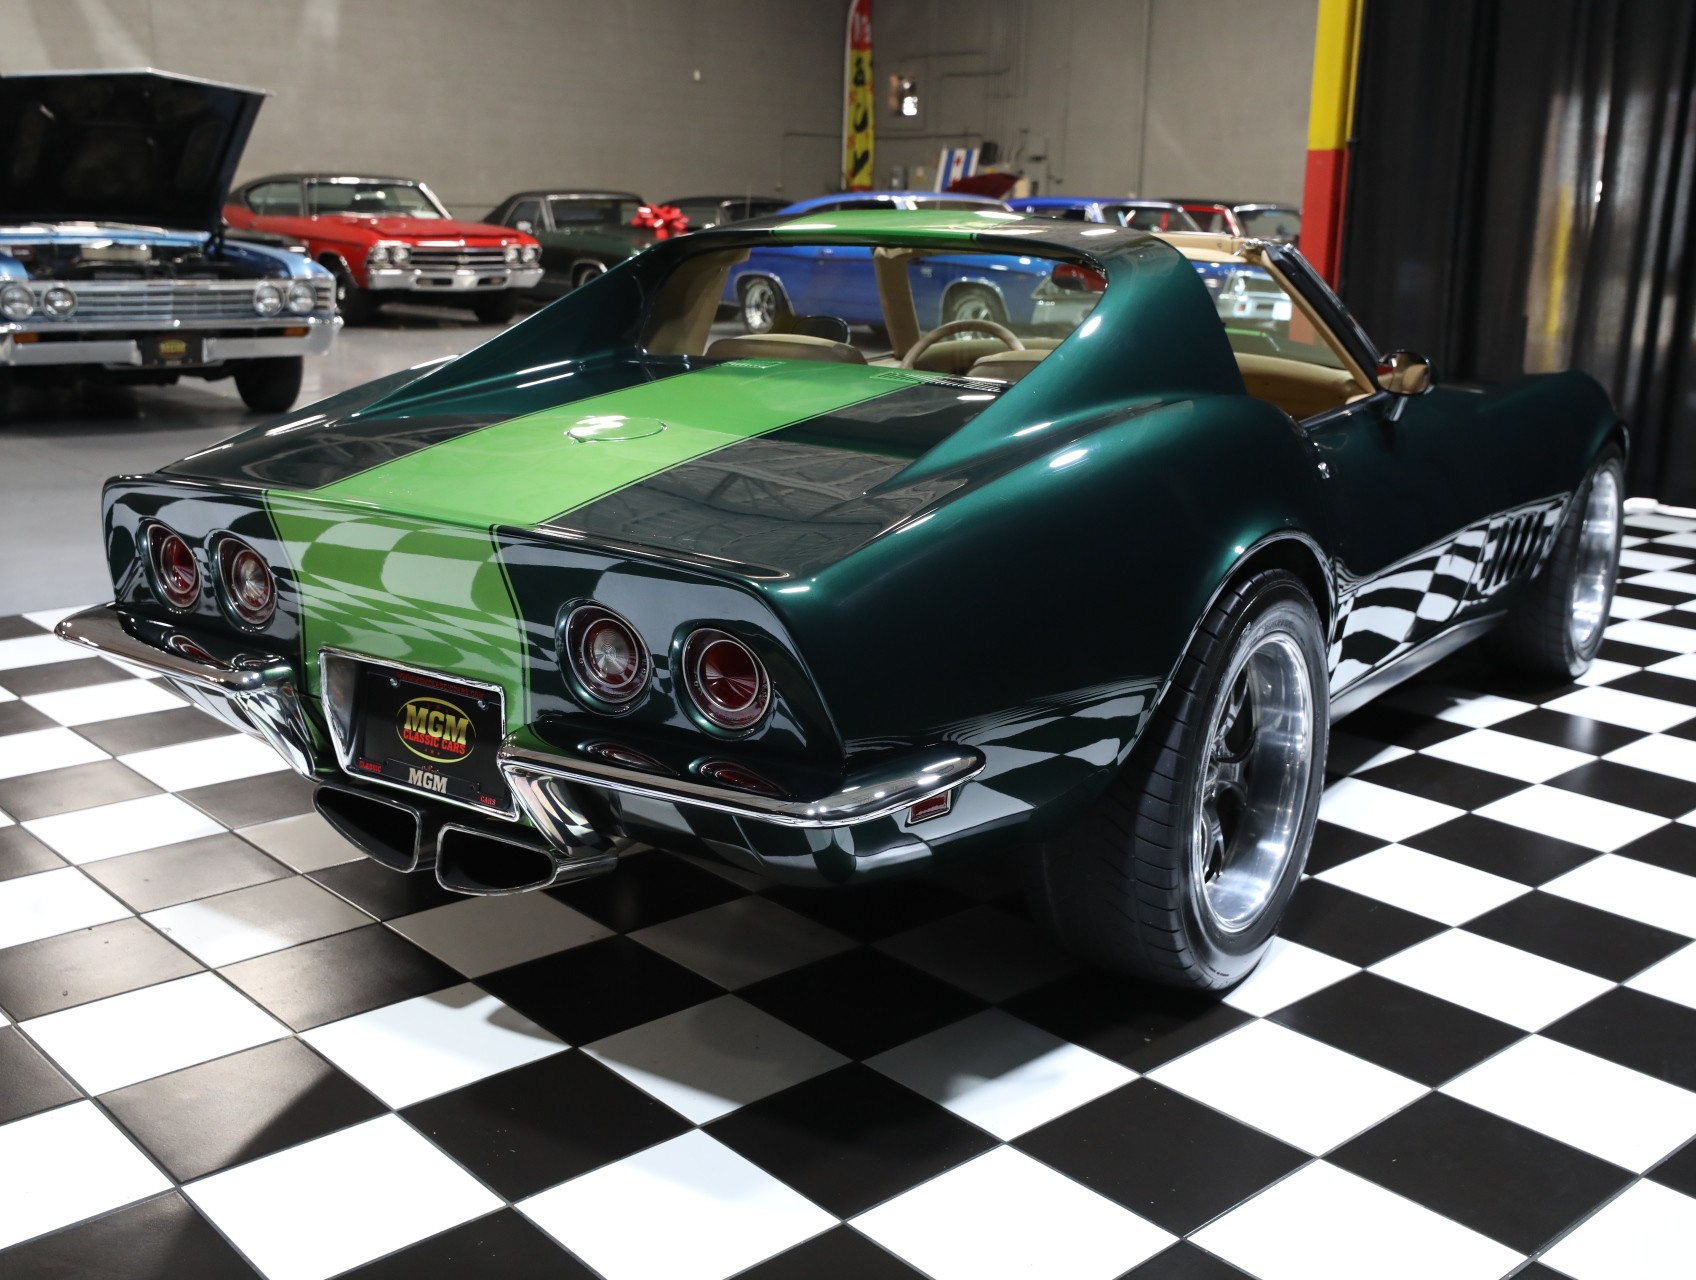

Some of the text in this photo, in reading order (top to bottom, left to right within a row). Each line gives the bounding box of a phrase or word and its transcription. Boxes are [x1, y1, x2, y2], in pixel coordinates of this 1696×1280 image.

[404, 704, 469, 745] MGM
[403, 729, 466, 754] CLASSIC CARS
[359, 761, 382, 773] CLASSIC
[408, 767, 449, 794] MGM
[480, 795, 496, 806] CARS
